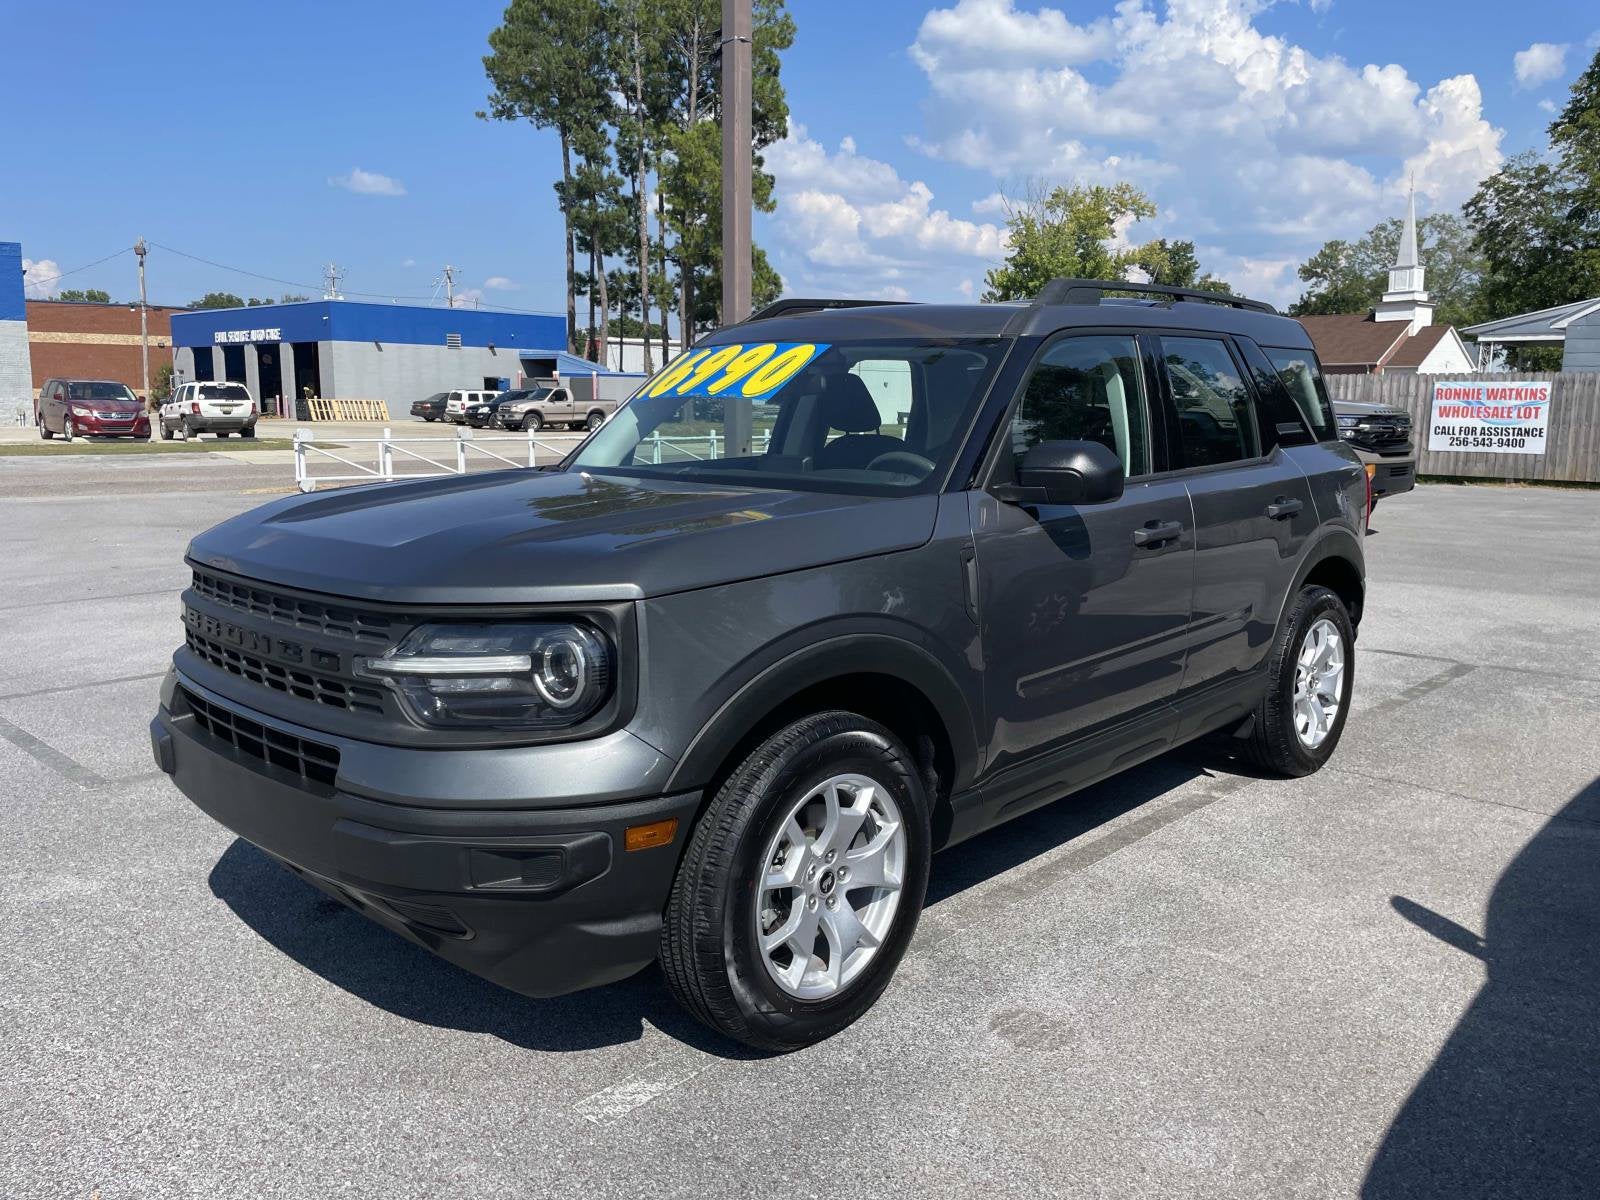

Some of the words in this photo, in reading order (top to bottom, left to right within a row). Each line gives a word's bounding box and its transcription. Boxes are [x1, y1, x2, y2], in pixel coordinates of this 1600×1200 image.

[636, 343, 816, 398] 16990
[1436, 388, 1482, 400] RONNIE
[1486, 388, 1547, 401] WATKINS
[1438, 406, 1513, 419] WHOLESALE
[1517, 407, 1542, 419] LOT
[1434, 426, 1456, 436] CALL
[1459, 426, 1477, 436] FOR
[1480, 427, 1544, 438] ASSISTANCE
[1449, 437, 1525, 448] 256-543-9400
[186, 607, 341, 672] BRONCO
